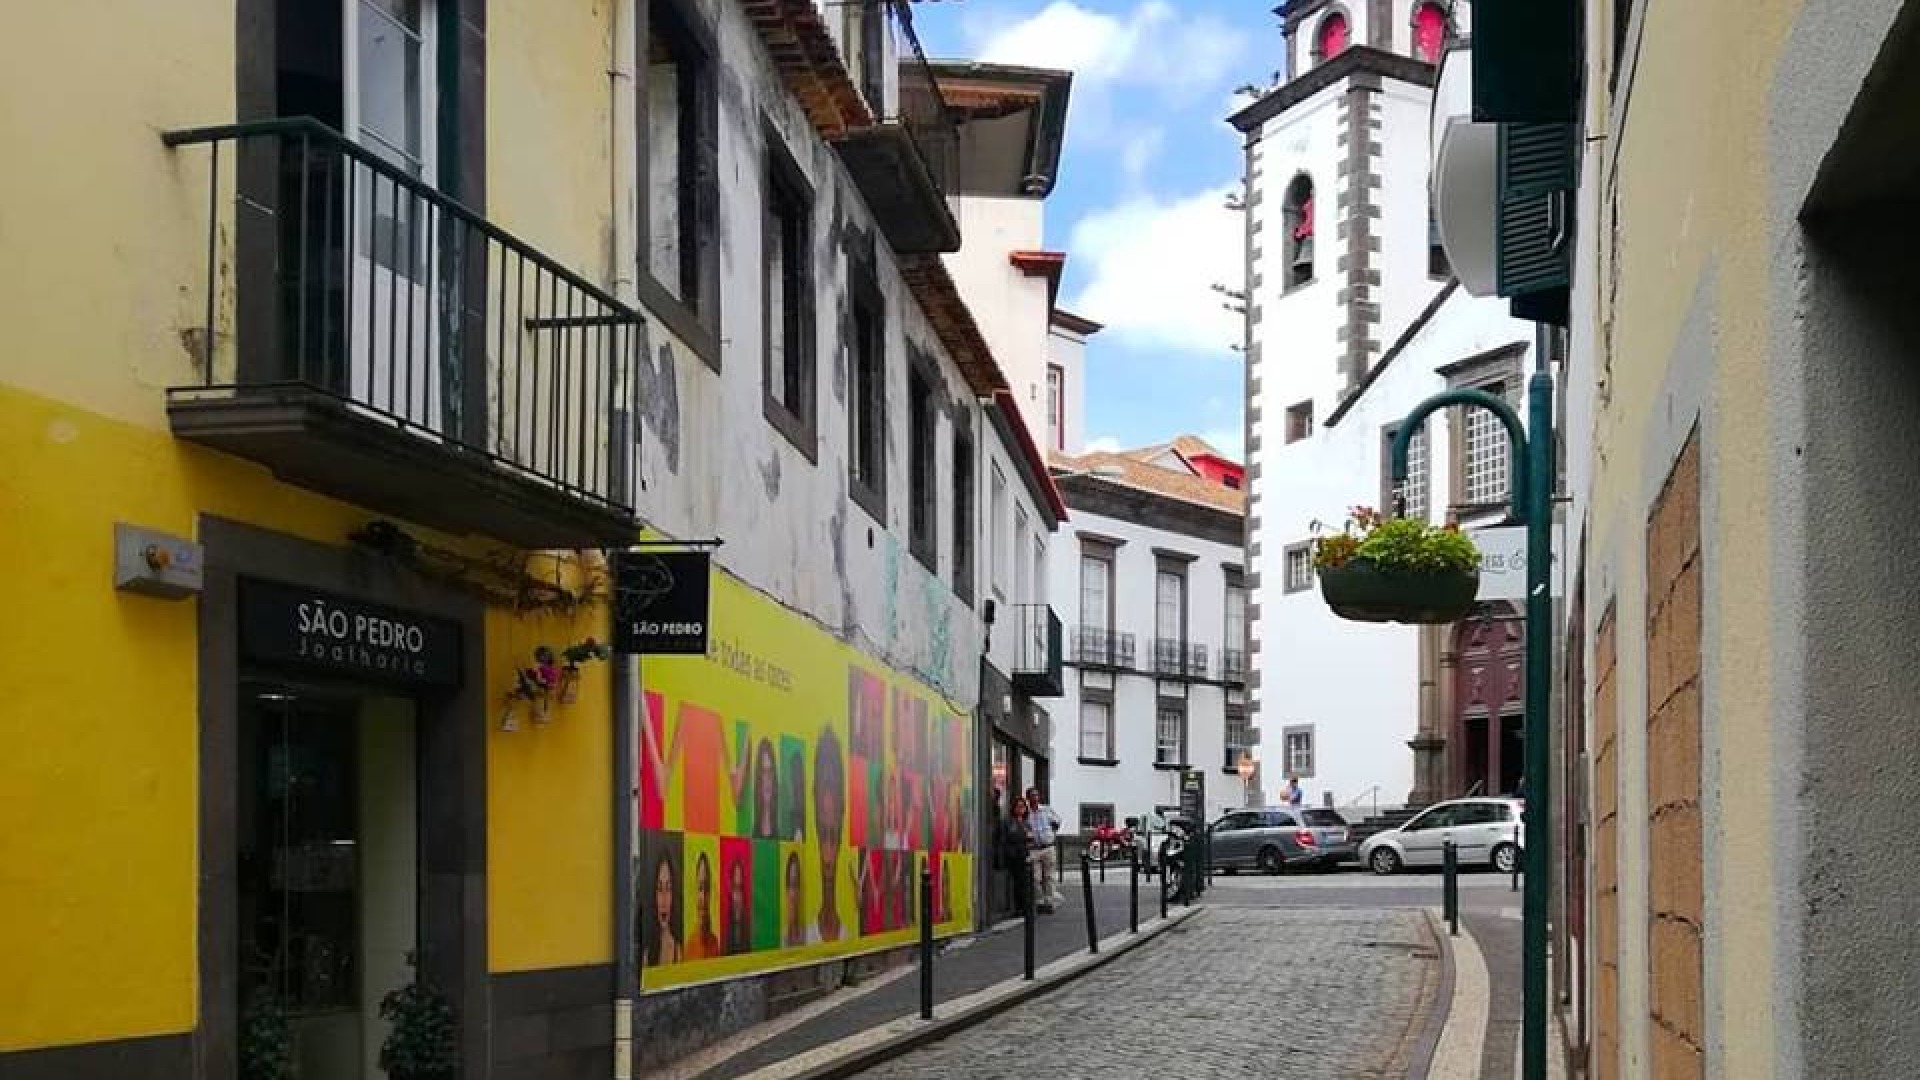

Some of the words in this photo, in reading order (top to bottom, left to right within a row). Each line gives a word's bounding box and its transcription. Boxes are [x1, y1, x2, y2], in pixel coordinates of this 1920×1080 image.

[298, 599, 349, 639] SÃO
[355, 614, 424, 653] PEDRO
[661, 620, 703, 637] PEDRO
